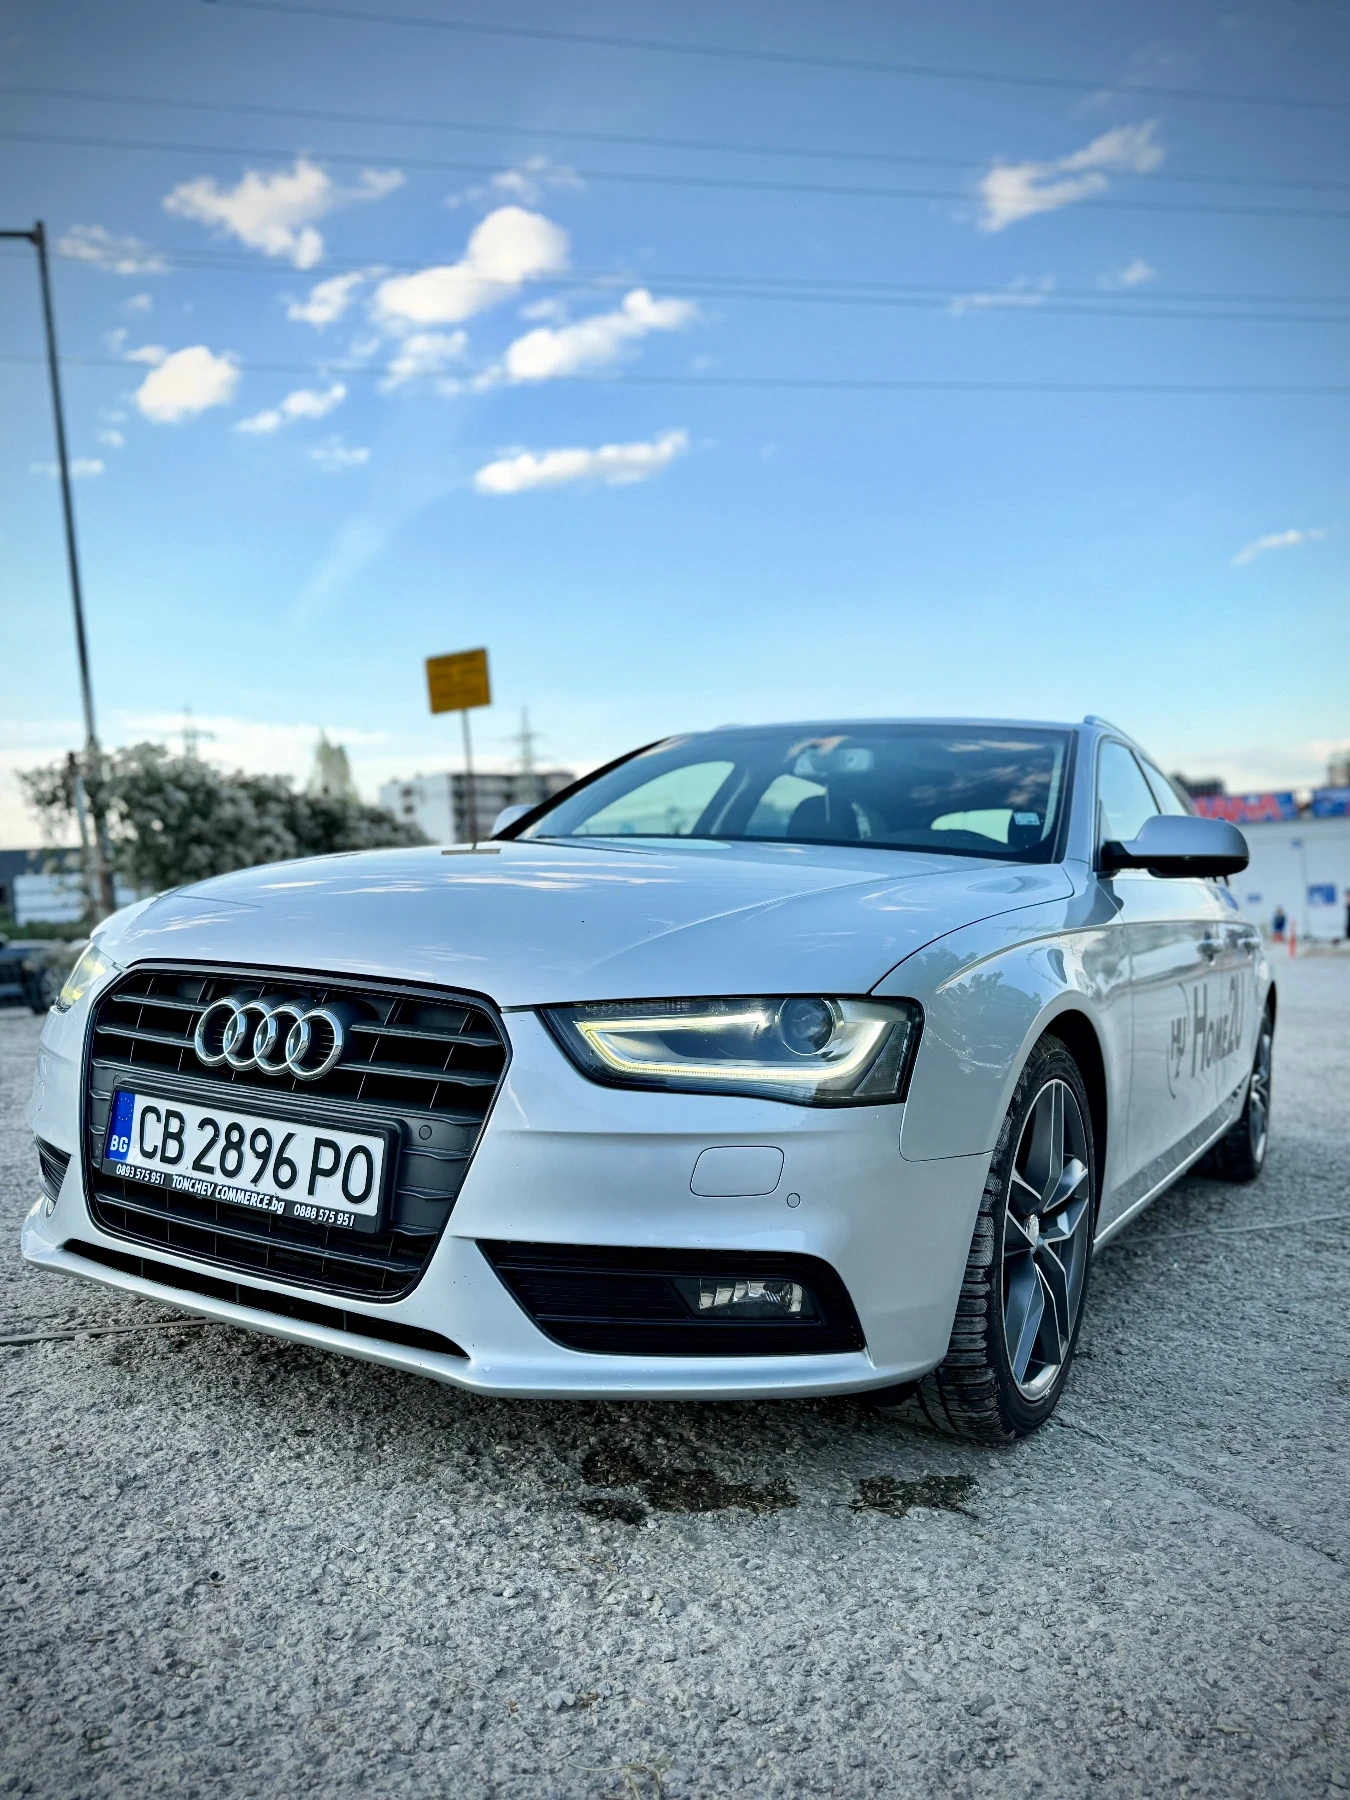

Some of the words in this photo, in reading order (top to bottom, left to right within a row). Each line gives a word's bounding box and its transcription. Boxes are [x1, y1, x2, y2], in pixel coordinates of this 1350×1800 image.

[110, 1134, 129, 1153] BG
[139, 1104, 186, 1166] CB
[191, 1117, 298, 1190] 2896
[307, 1136, 375, 1205] PO
[116, 1164, 134, 1178] 0893
[135, 1169, 150, 1181] 575
[150, 1173, 165, 1185] 951
[172, 1175, 214, 1196] TONCHEV
[215, 1186, 285, 1214] COMMERCE.bg
[293, 1203, 317, 1219] 0888
[318, 1208, 336, 1223] 575
[336, 1213, 355, 1227] 951
